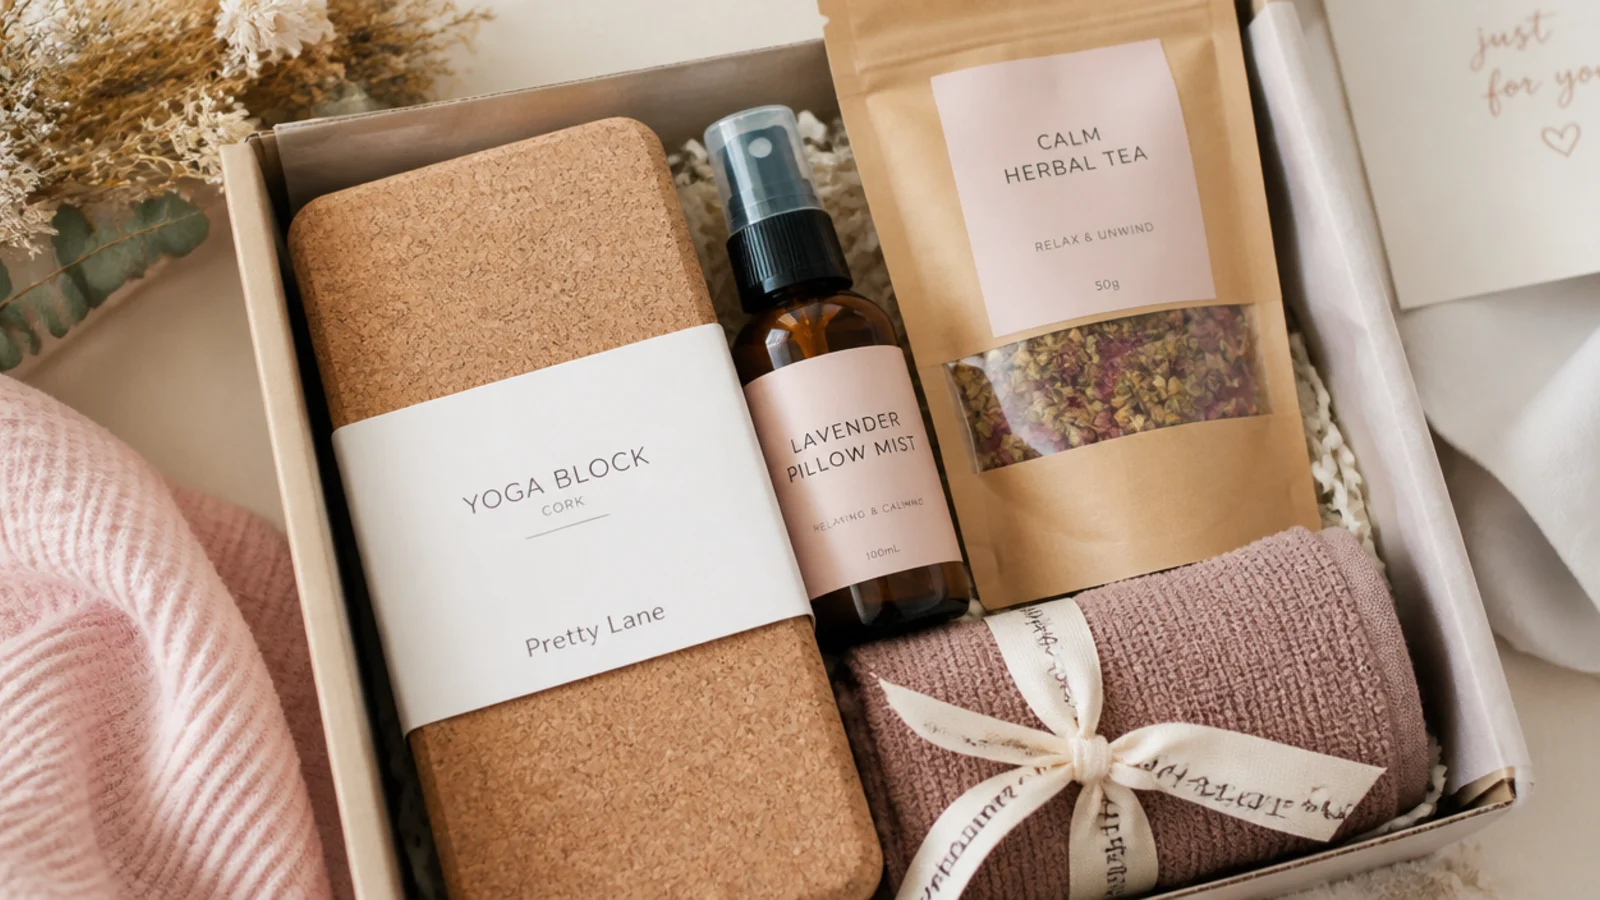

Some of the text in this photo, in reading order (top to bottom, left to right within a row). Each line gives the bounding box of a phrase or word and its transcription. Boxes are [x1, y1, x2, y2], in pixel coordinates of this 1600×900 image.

[1469, 9, 1556, 73] just
[1481, 67, 1543, 118] for
[1037, 127, 1101, 150] CALM
[1004, 146, 1148, 184] HERBAL TEA
[1034, 222, 1154, 252] RELAX & UNWIND
[790, 411, 900, 454] LAVENDER
[787, 435, 916, 483] PILLOW MIST
[462, 446, 650, 515] YOGA BLOCK
[541, 495, 586, 517] CORK
[871, 506, 878, 516] &
[866, 544, 901, 561] 100mL
[525, 605, 666, 658] Pretty Lane
